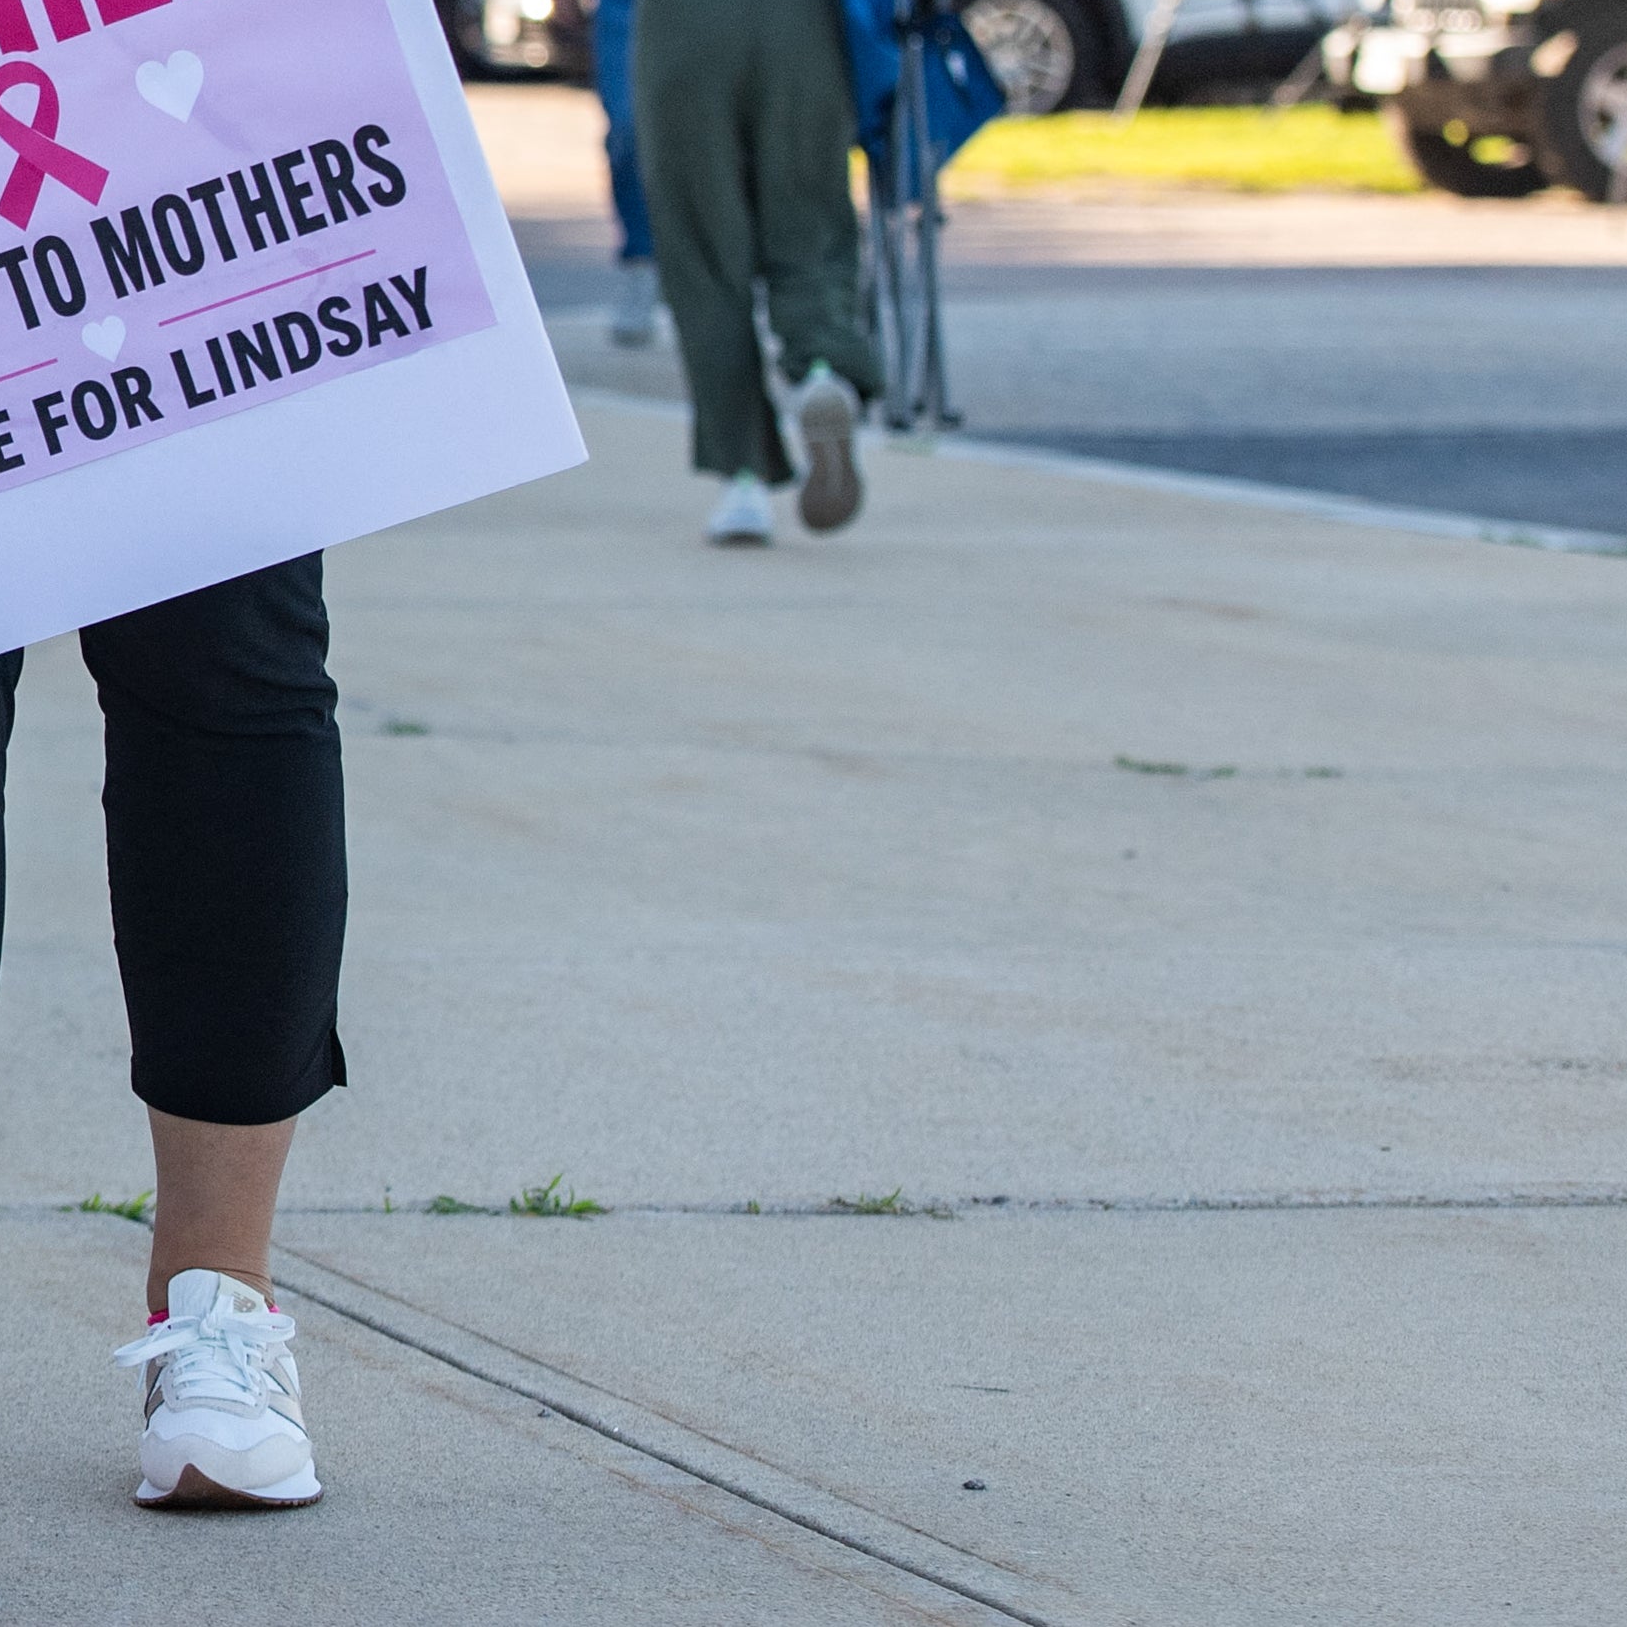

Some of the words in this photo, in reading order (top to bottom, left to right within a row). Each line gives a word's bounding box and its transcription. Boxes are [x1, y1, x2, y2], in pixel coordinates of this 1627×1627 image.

[89, 125, 406, 299] MOTHERS
[33, 367, 164, 456] FOR
[171, 267, 433, 409] LINDSAY
